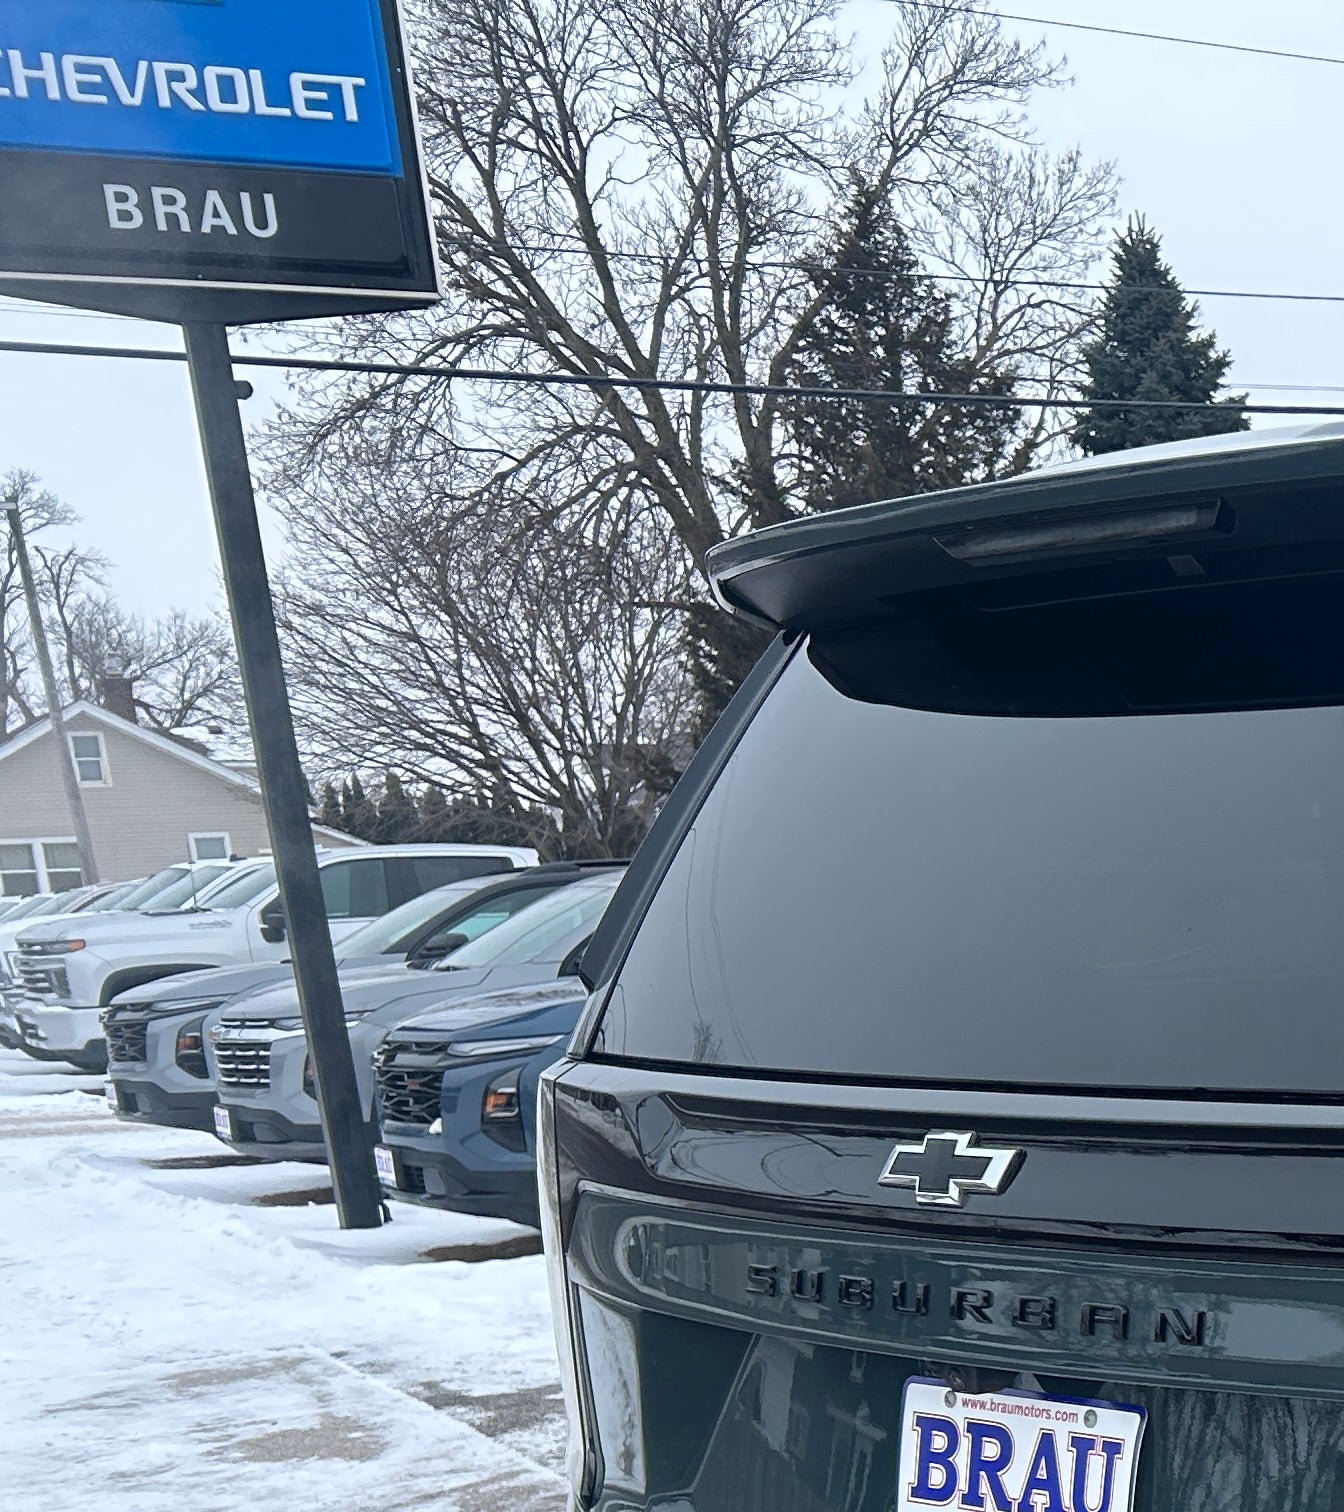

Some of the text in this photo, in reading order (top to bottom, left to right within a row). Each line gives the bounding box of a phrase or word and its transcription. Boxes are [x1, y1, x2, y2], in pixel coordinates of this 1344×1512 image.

[0, 48, 366, 123] HEVROLET
[103, 184, 279, 238] BRAU
[746, 1263, 1207, 1347] SUBURBAN
[961, 1397, 1079, 1424] www.braumotors.com
